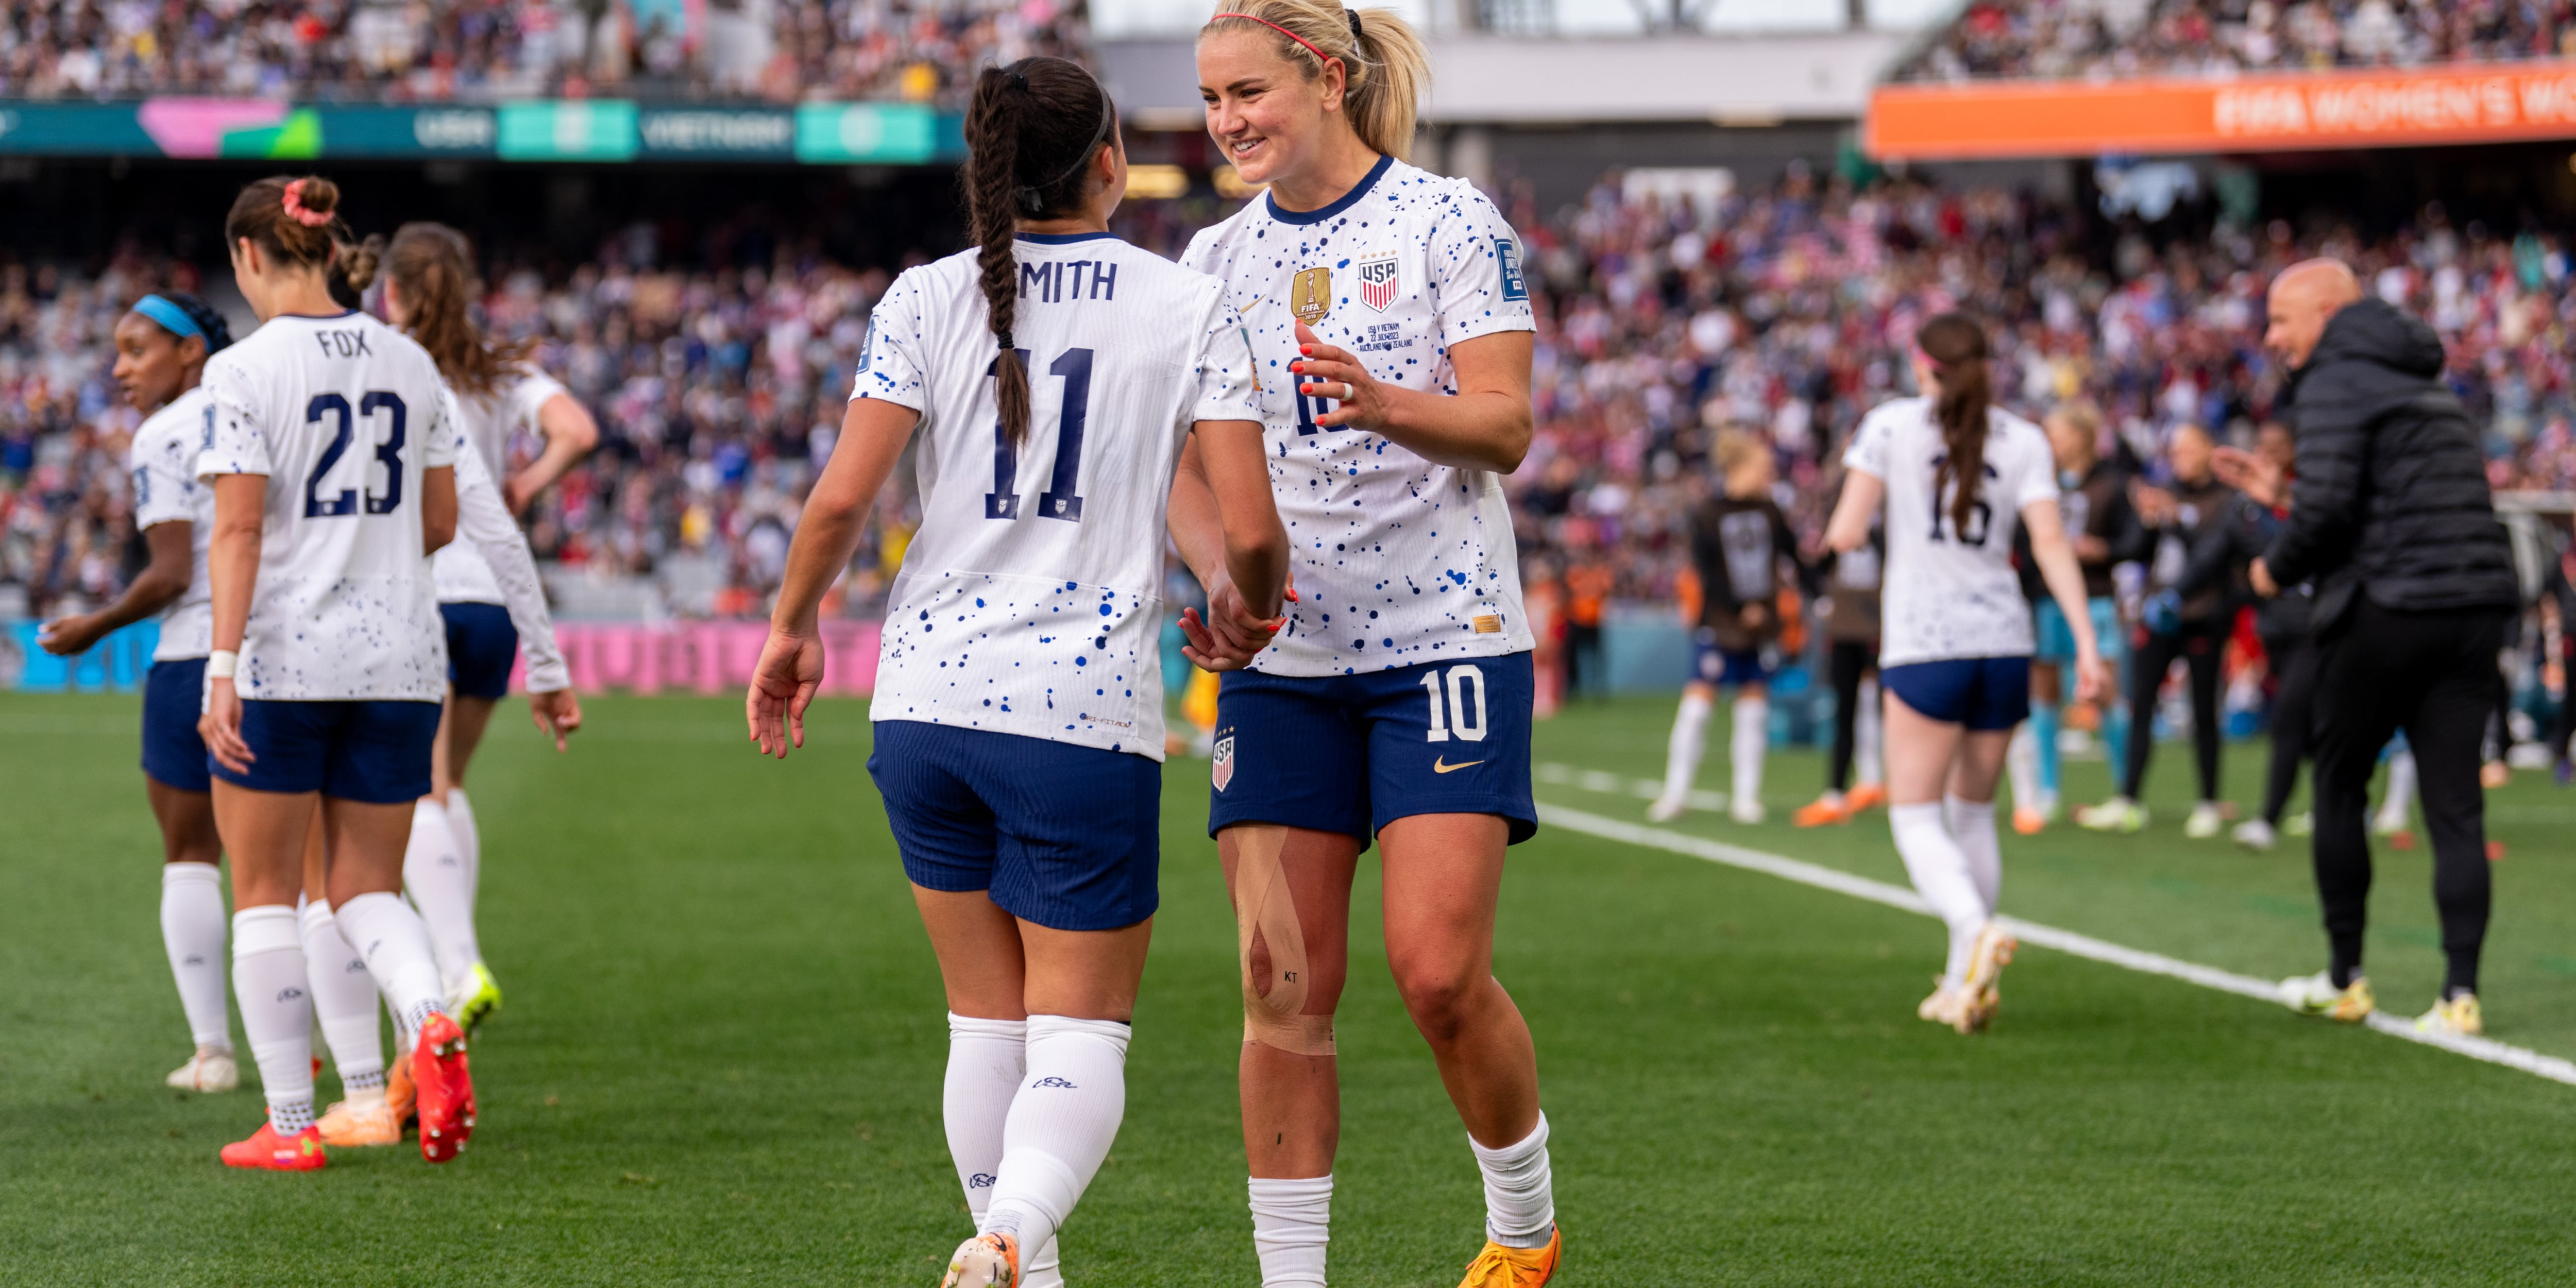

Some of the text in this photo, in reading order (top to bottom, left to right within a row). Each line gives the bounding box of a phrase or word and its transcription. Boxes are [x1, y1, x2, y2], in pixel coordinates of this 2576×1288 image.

[1014, 260, 1117, 303] MITH
[1362, 262, 1395, 283] USA
[1301, 303, 1319, 313] FIFA
[1368, 325, 1376, 334] USA
[1381, 323, 1400, 331] VIETNAM
[315, 329, 372, 358] FOX
[1359, 339, 1412, 352] AUCKLAND NEW ZEALAND
[985, 347, 1094, 522] 11
[302, 390, 407, 519] 23
[1419, 664, 1487, 742] 10
[1214, 740, 1232, 762] USA
[1284, 971, 1297, 984] KT
